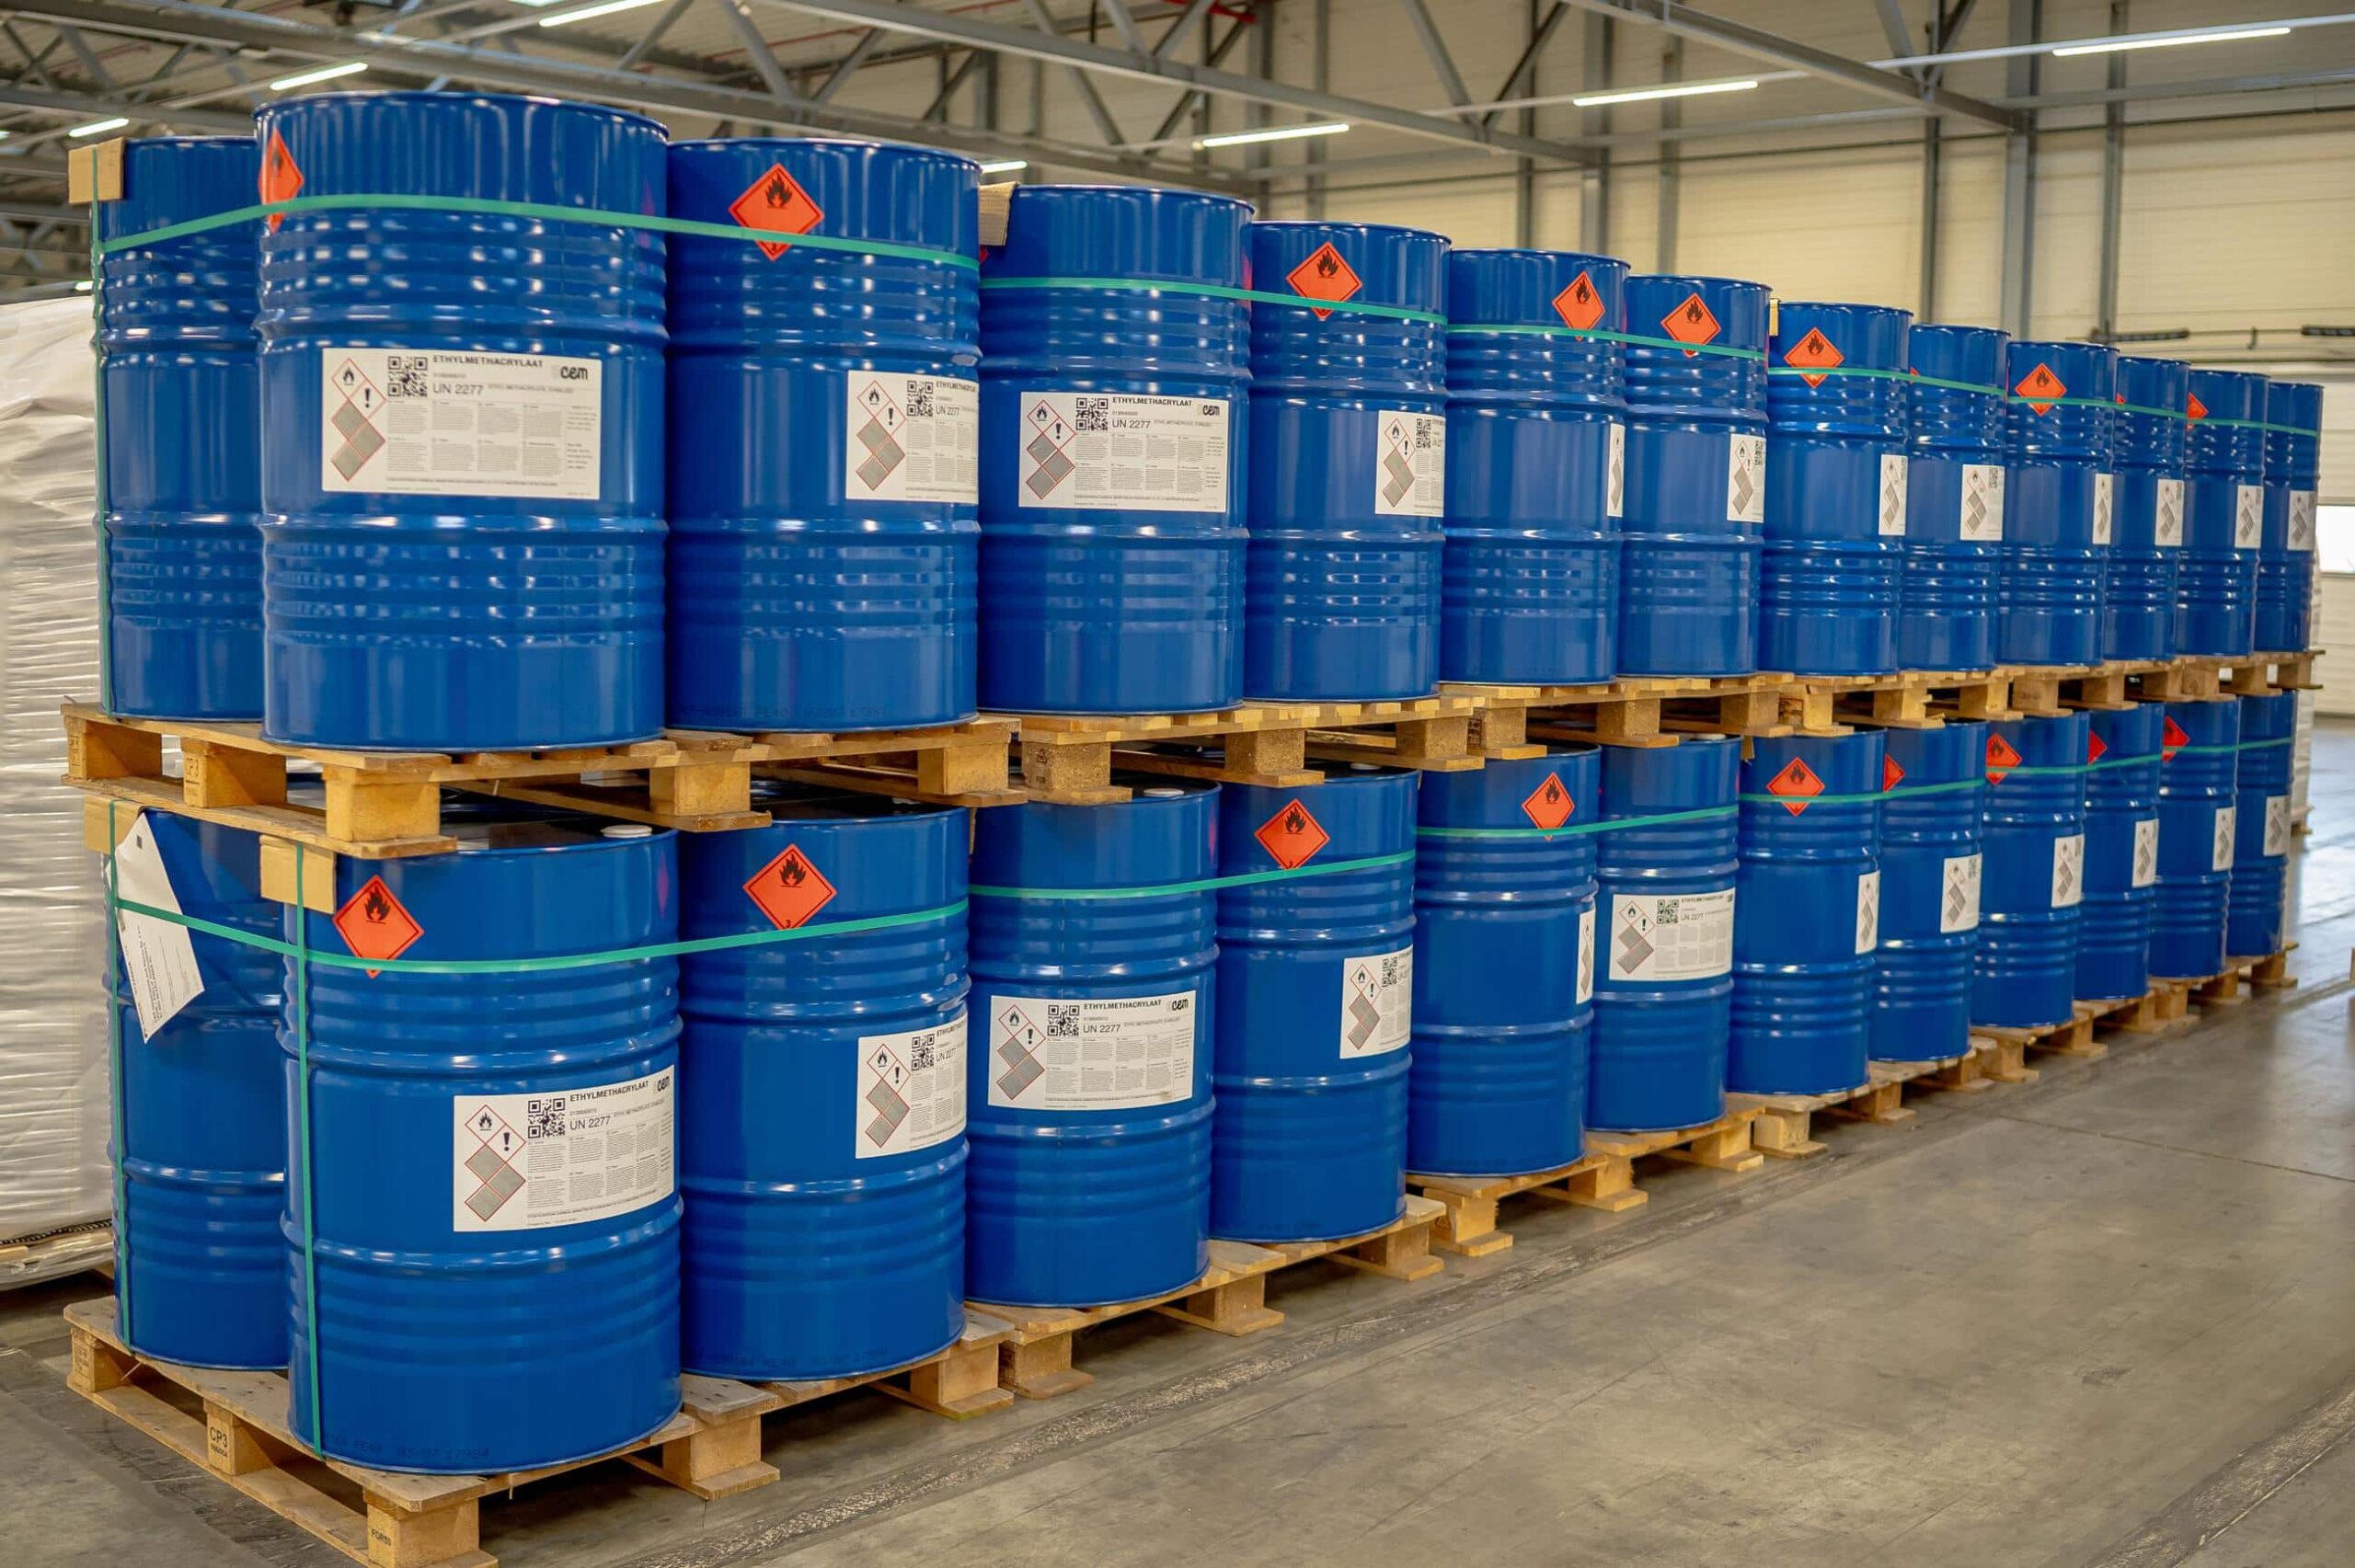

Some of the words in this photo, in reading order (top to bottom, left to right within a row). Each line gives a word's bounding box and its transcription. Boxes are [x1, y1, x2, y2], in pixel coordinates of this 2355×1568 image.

[433, 355, 544, 368] ETHYLMETHACRYLAAT
[432, 383, 452, 395] UN
[454, 383, 484, 395] 2277
[1112, 396, 1192, 406] ETHYLMETHACRYLAAT
[936, 405, 946, 415] UN
[1112, 419, 1127, 429] UN
[1129, 420, 1151, 429] 2277
[785, 919, 791, 928] 3
[1084, 1000, 1162, 1010] ETHYLMETHACRYLAAT
[1083, 1024, 1097, 1033] UN
[1098, 1024, 1120, 1033] 2277
[569, 1080, 649, 1102] ETHYLMETHACRYLAAT
[569, 1120, 586, 1130] UN
[588, 1116, 611, 1128] 2277
[210, 1426, 228, 1448] CP3
